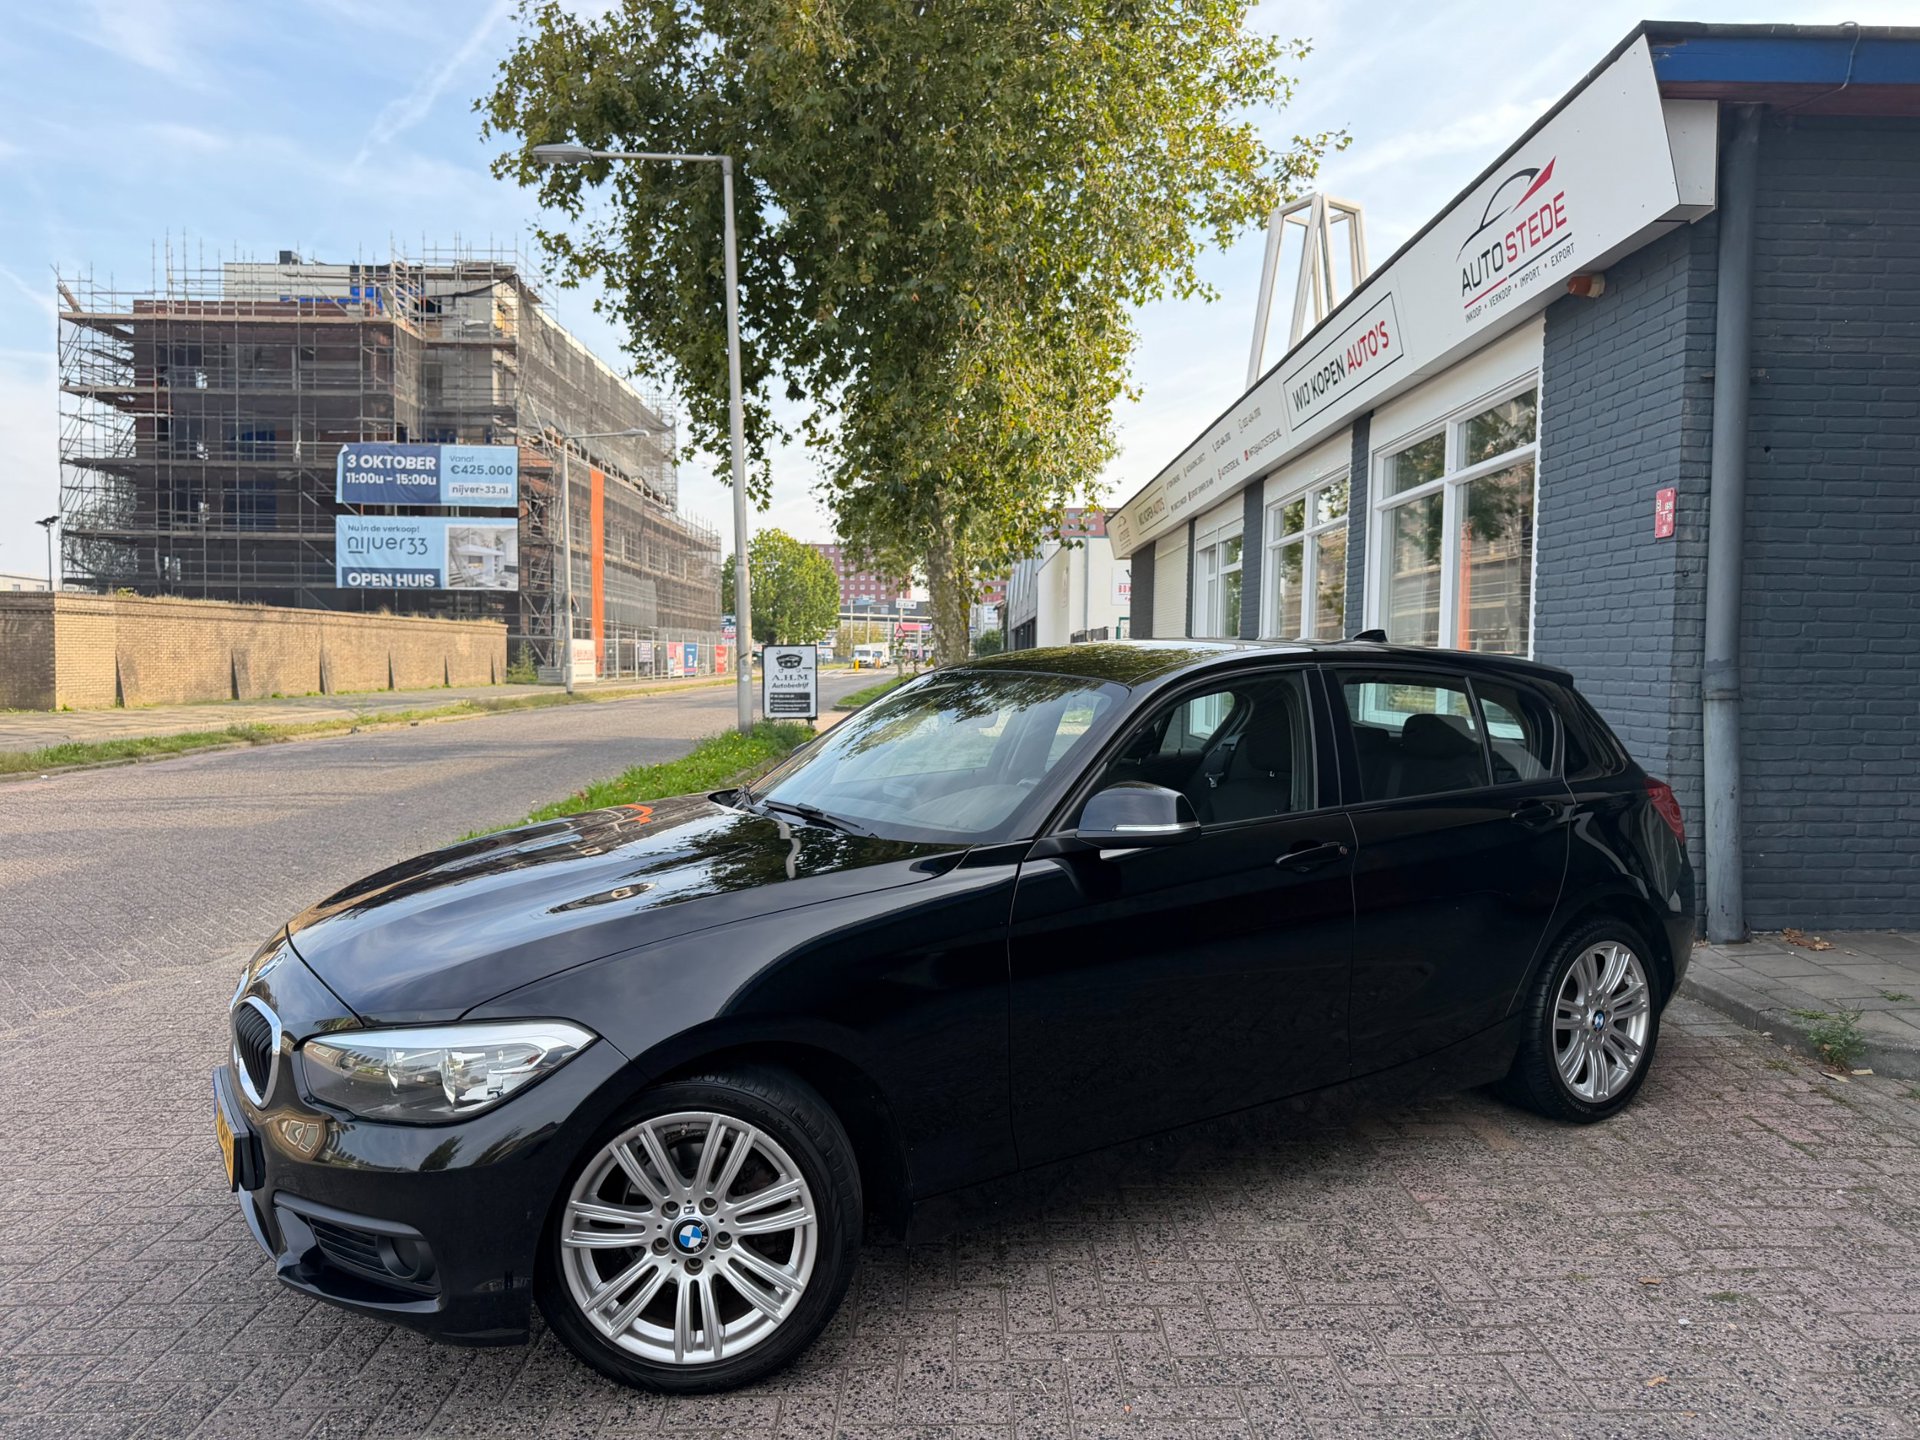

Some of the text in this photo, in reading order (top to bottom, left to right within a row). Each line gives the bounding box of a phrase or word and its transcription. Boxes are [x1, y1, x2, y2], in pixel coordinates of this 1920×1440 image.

[1462, 191, 1567, 297] AUTOSTEDE
[1489, 285, 1513, 308] VERKOOP
[1519, 266, 1541, 288] IMPORT
[1550, 242, 1575, 267] EXPORT
[1292, 320, 1389, 412] WIJ KOPEN AUTO'S
[346, 454, 437, 470] 3 OKTOBER
[450, 464, 513, 476] €425.000
[345, 472, 384, 484] 11:00u
[395, 473, 437, 485] 15:00u
[452, 485, 509, 495] nijver-33.nl
[347, 572, 436, 587] OPEN HUIS
